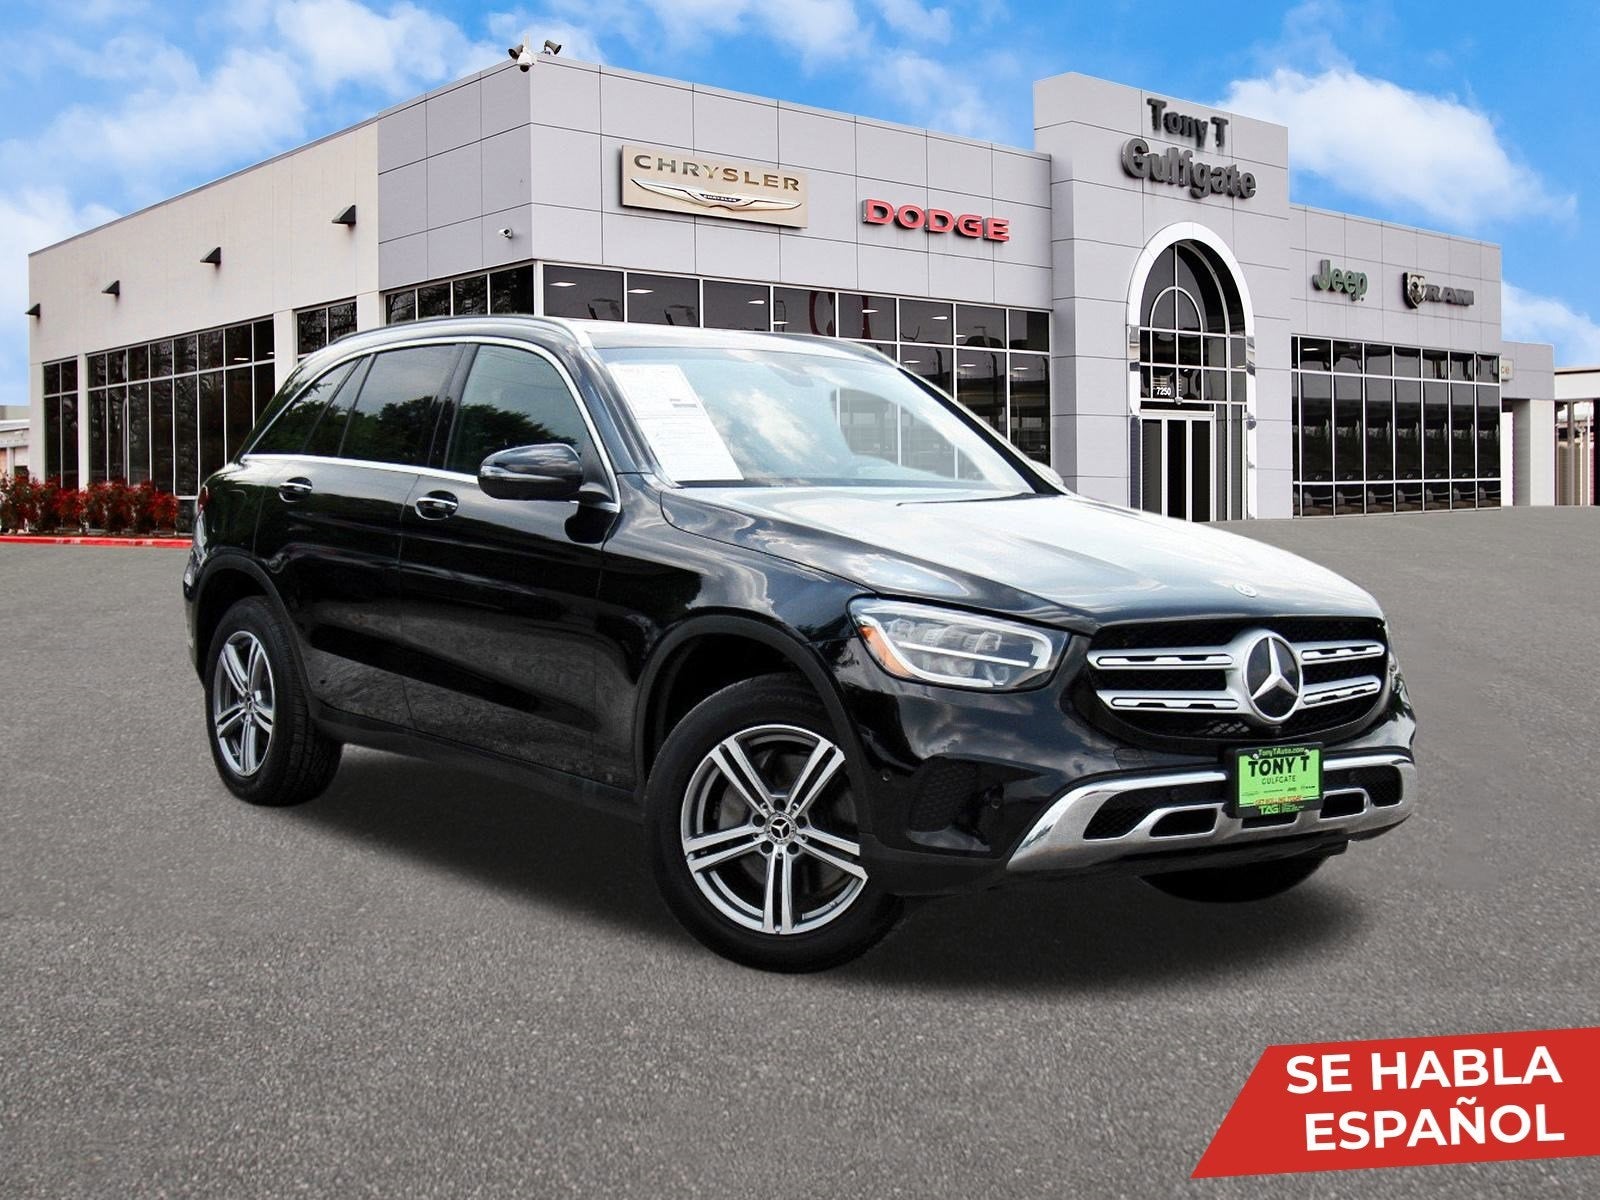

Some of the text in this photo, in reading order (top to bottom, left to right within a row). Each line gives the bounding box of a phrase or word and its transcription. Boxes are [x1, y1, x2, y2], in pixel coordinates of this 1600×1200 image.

[1147, 98, 1229, 147] Tony T
[633, 154, 801, 192] CHRYSLER
[1121, 138, 1257, 199] Gulfgate
[863, 198, 1011, 242] DODGE
[1312, 259, 1368, 302] Jeep
[1425, 284, 1474, 306] RAM
[1156, 386, 1171, 396] 7250
[1248, 756, 1310, 777] TONY T
[1261, 775, 1296, 785] GULFGATE
